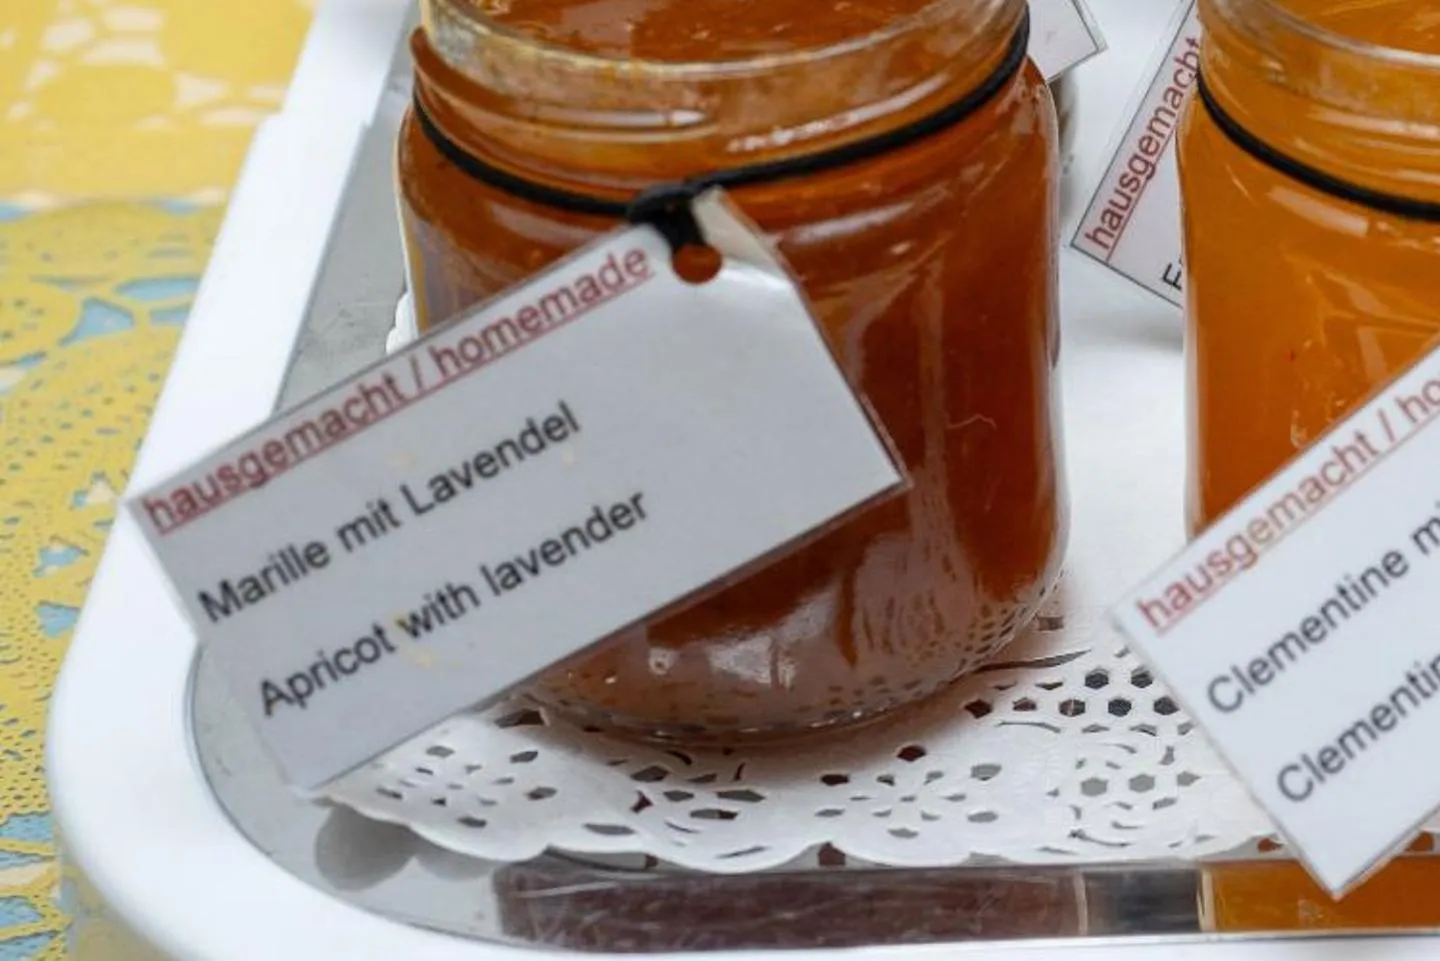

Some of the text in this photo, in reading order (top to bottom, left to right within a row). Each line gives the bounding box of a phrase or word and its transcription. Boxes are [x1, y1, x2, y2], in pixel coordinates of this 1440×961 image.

[143, 374, 406, 536] hausgemacht
[430, 243, 657, 385] homemade
[197, 400, 582, 623] Marille mit Lavendel
[259, 486, 652, 716] Apricot with lavender
[1136, 428, 1378, 638] hausgemacht
[1207, 548, 1411, 716] Clementine
